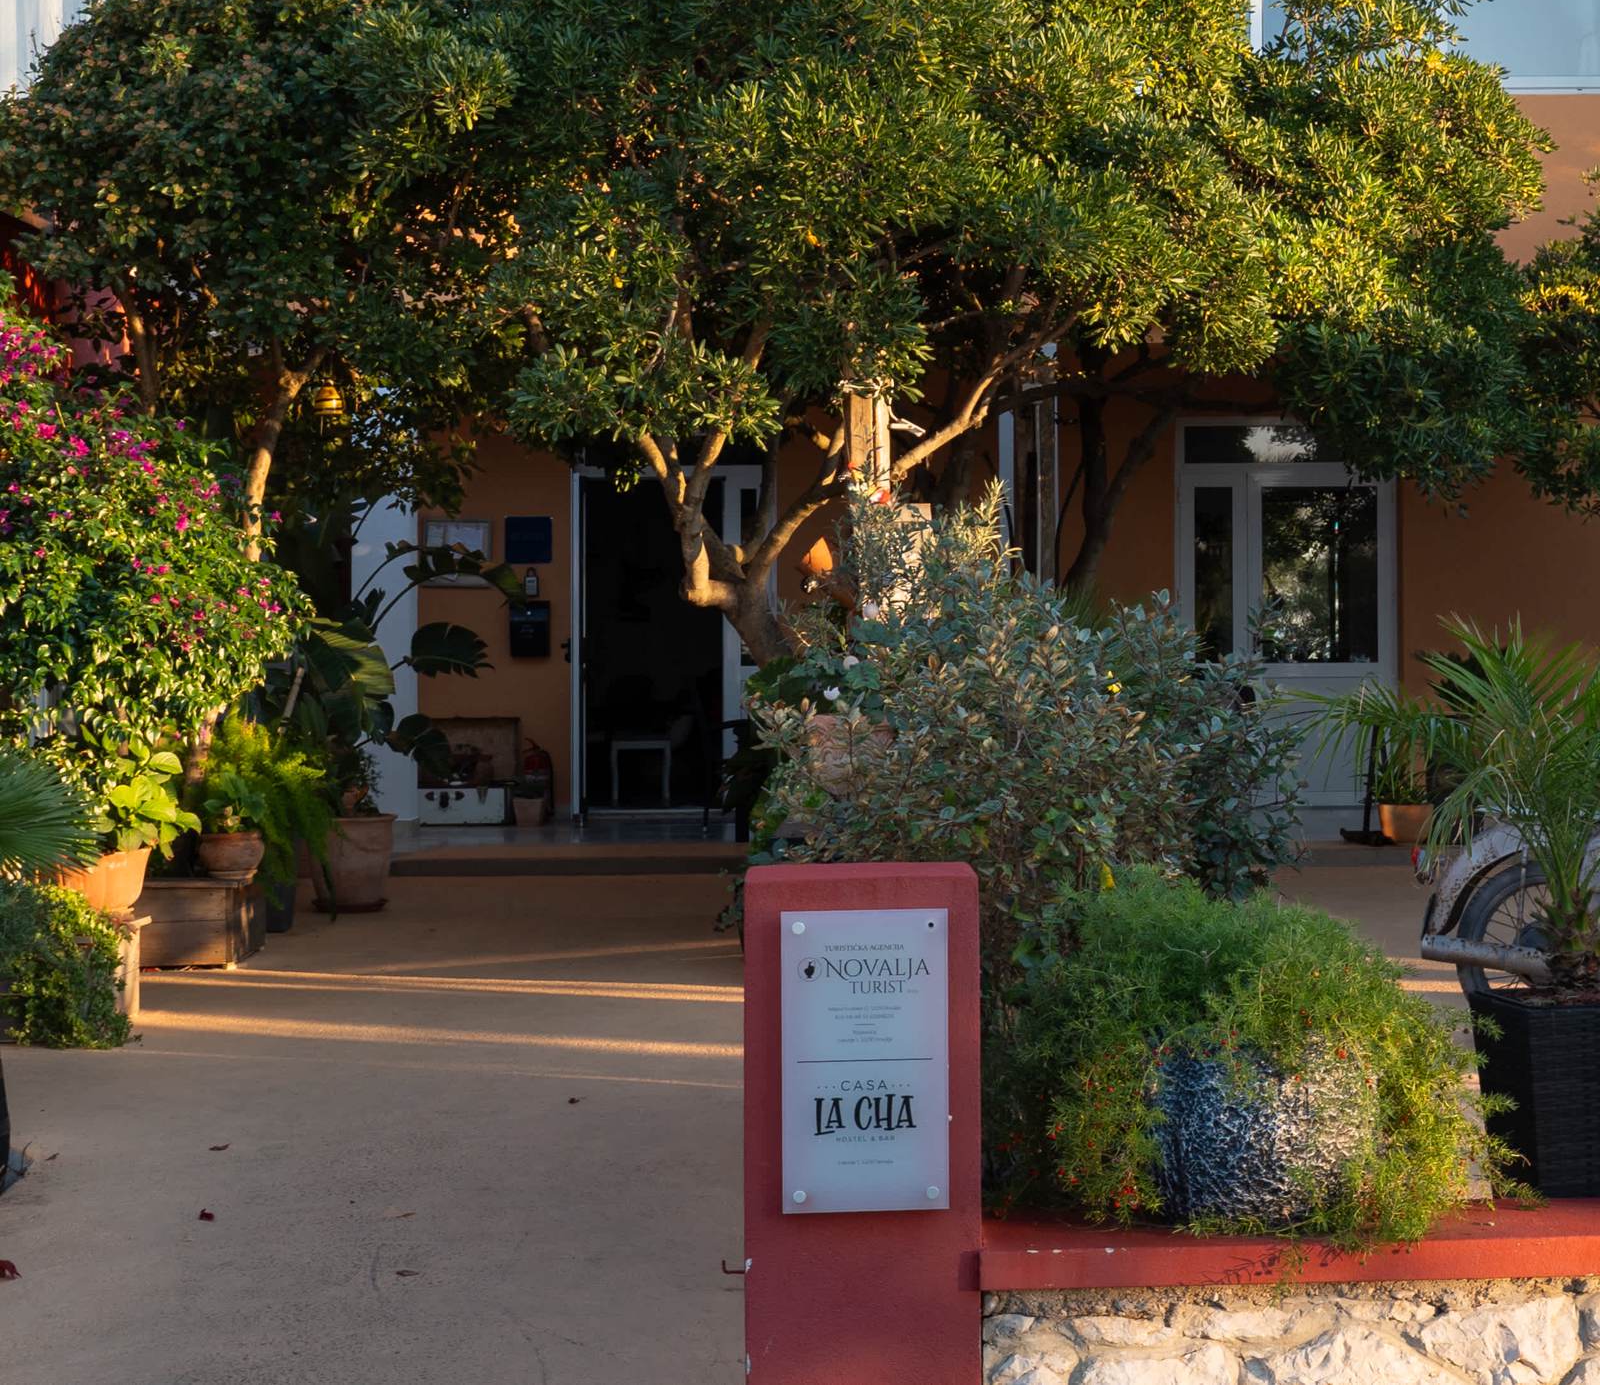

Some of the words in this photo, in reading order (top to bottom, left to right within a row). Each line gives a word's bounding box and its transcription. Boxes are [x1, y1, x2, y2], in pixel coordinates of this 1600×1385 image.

[821, 956, 930, 981] NOVALJA
[849, 980, 906, 994] TURIST
[841, 1080, 888, 1092] CASA
[814, 1097, 846, 1136] LA
[854, 1093, 917, 1131] CHA
